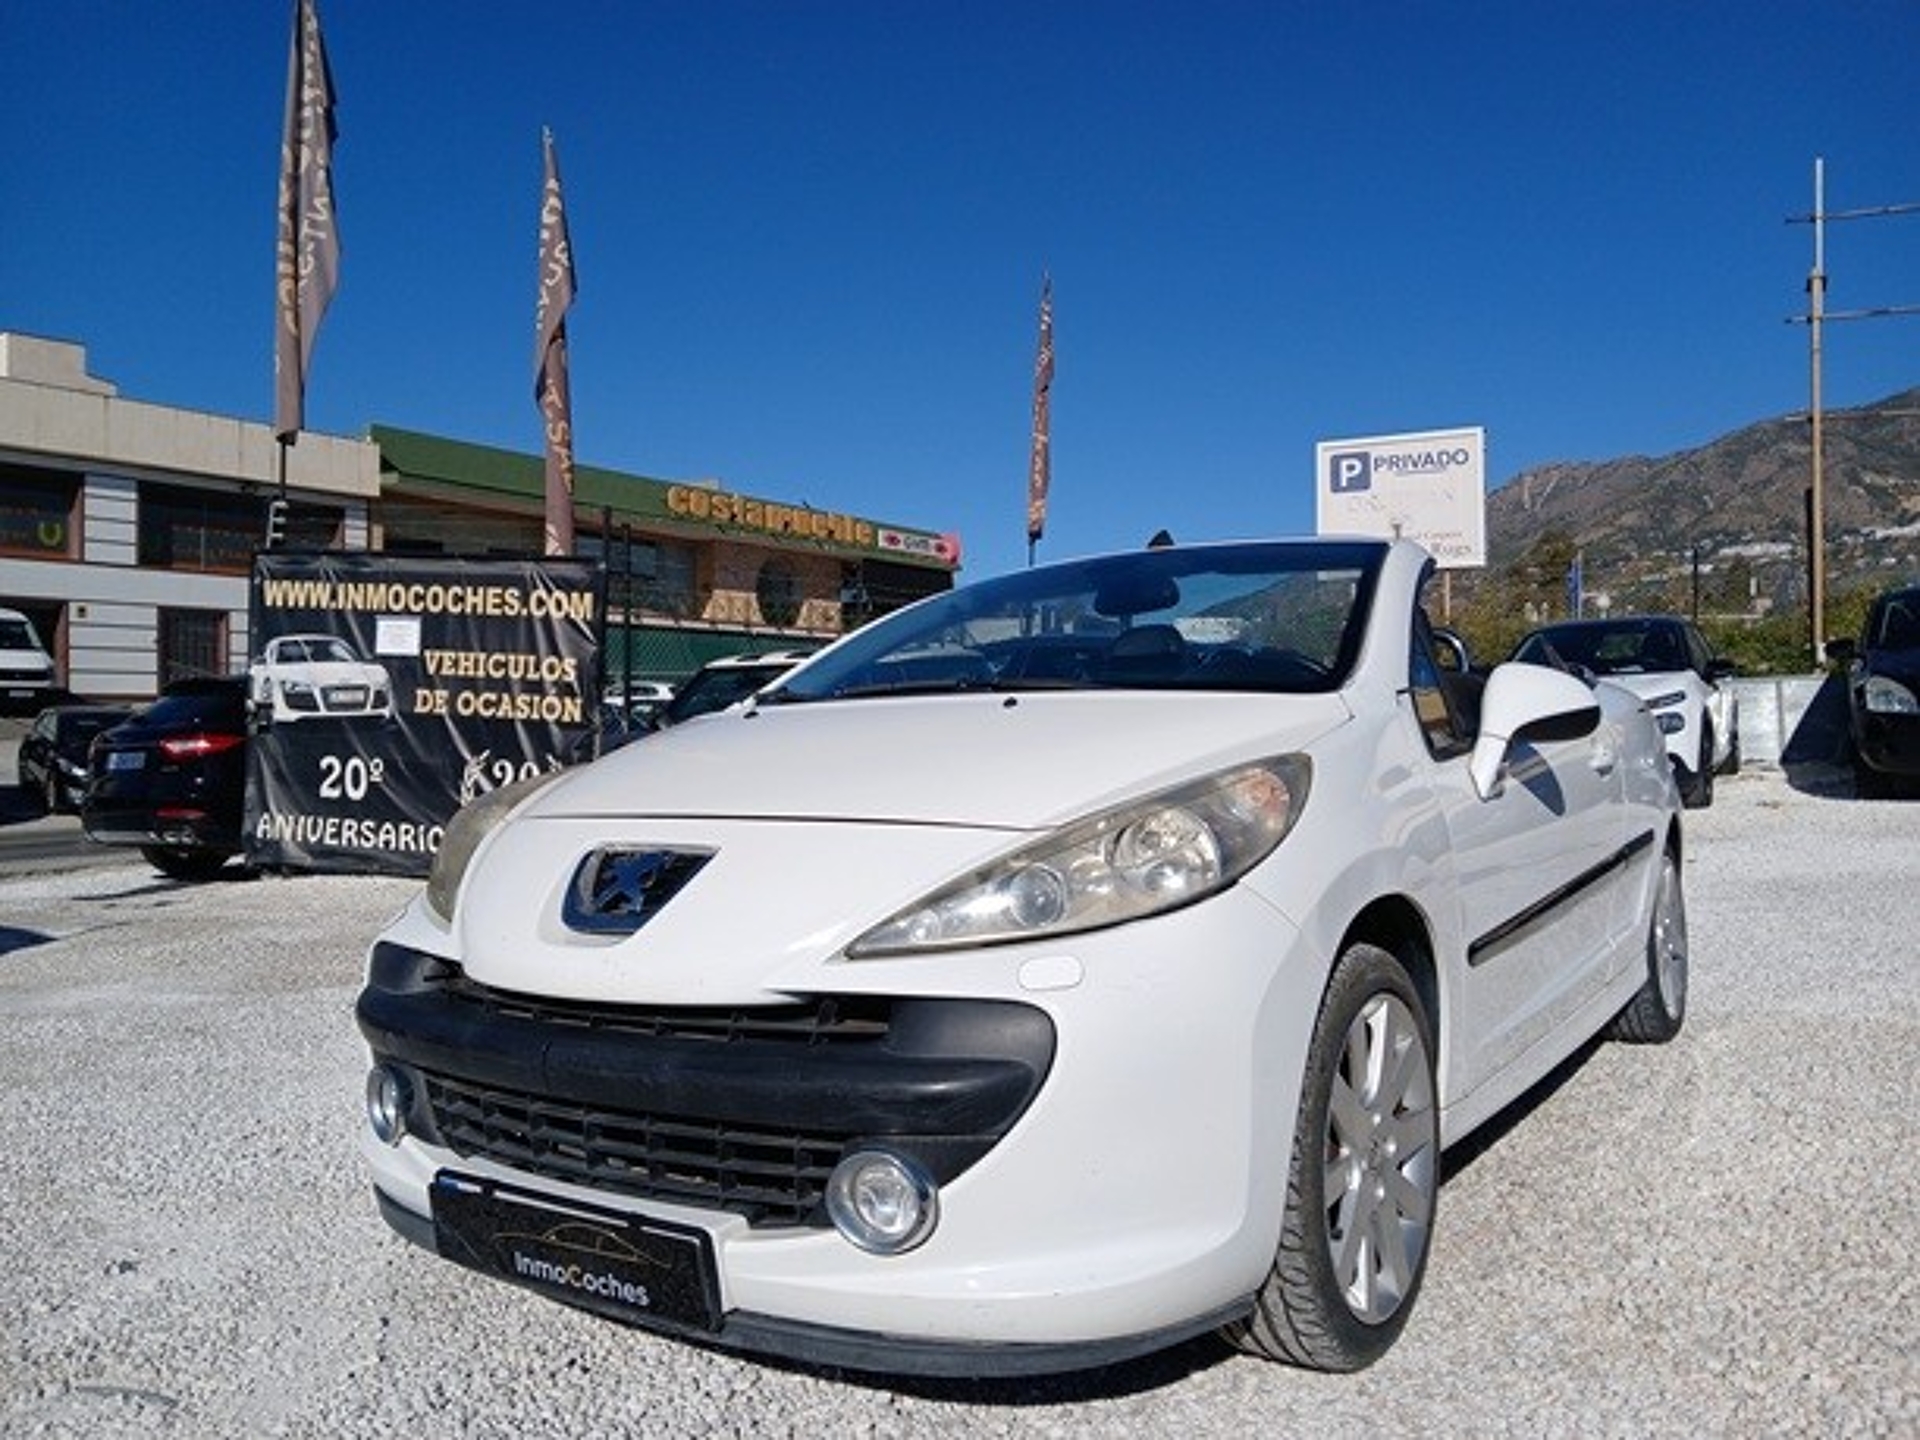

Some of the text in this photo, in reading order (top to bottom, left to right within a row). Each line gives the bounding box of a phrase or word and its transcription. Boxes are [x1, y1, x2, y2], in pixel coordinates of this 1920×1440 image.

[1339, 457, 1363, 488] P
[1373, 448, 1470, 472] PRIVADO
[263, 578, 594, 621] WWW.INMOCOCHES.COM
[423, 650, 578, 682] VEHICULOS
[413, 687, 582, 723] DE OCASIÓN
[318, 755, 384, 801] 20º
[256, 811, 446, 854] ANIVERSARIO
[514, 1251, 650, 1306] InmoCoches
